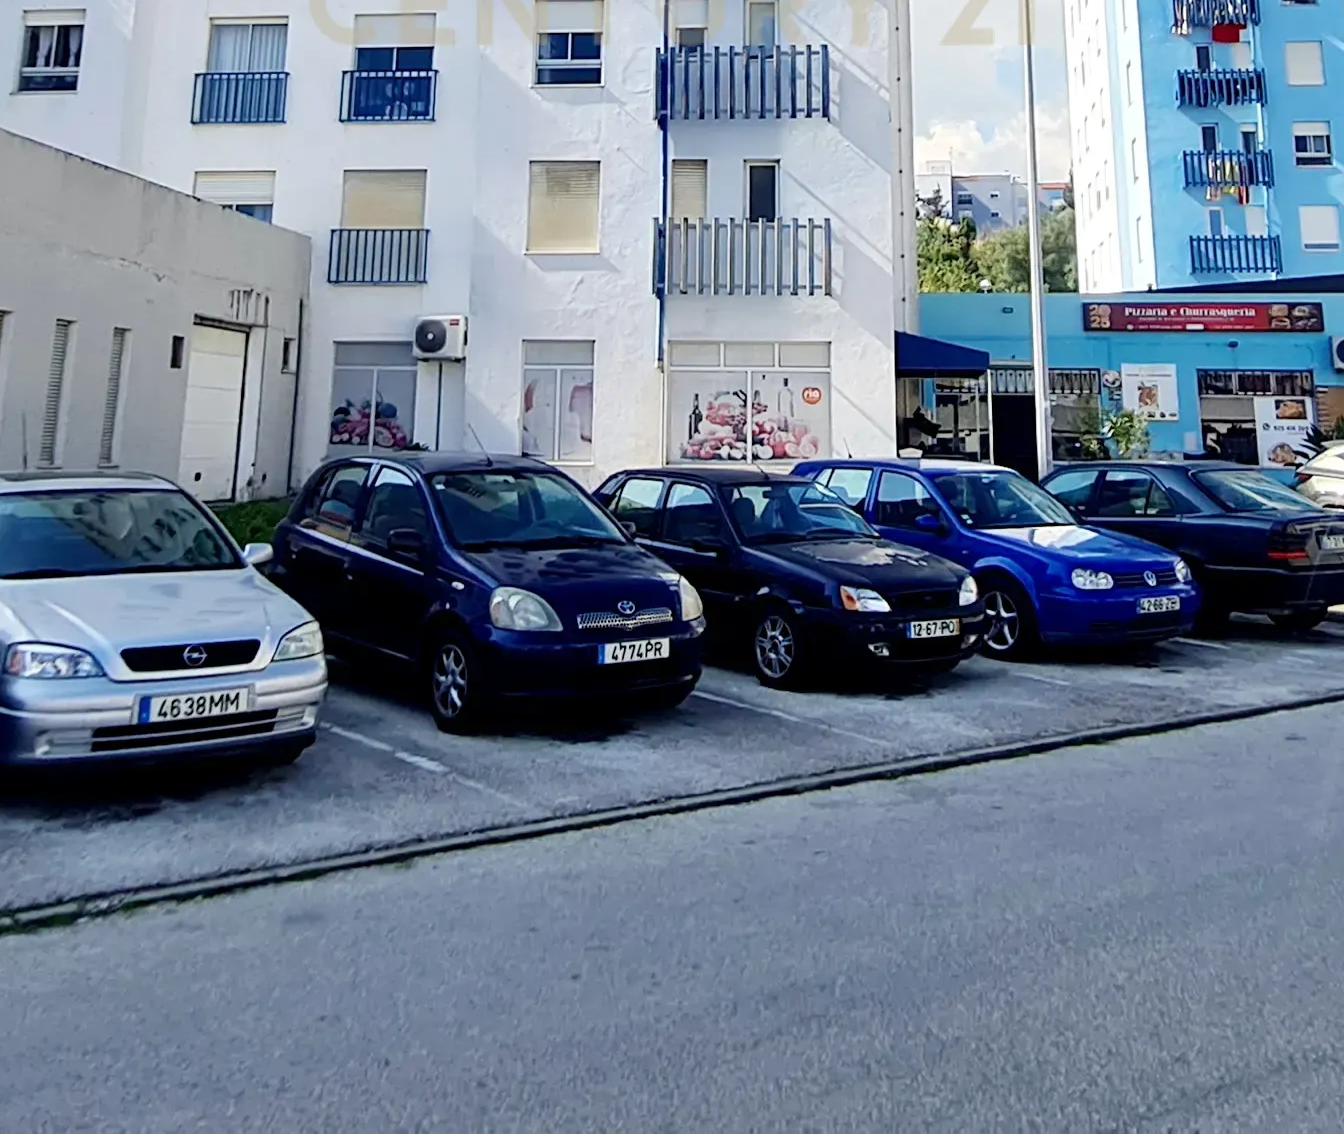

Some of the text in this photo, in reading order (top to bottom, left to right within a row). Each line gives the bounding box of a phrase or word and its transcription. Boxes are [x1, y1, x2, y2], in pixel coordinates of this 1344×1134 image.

[1124, 306, 1256, 318] Pizzaria e Churrasqueria
